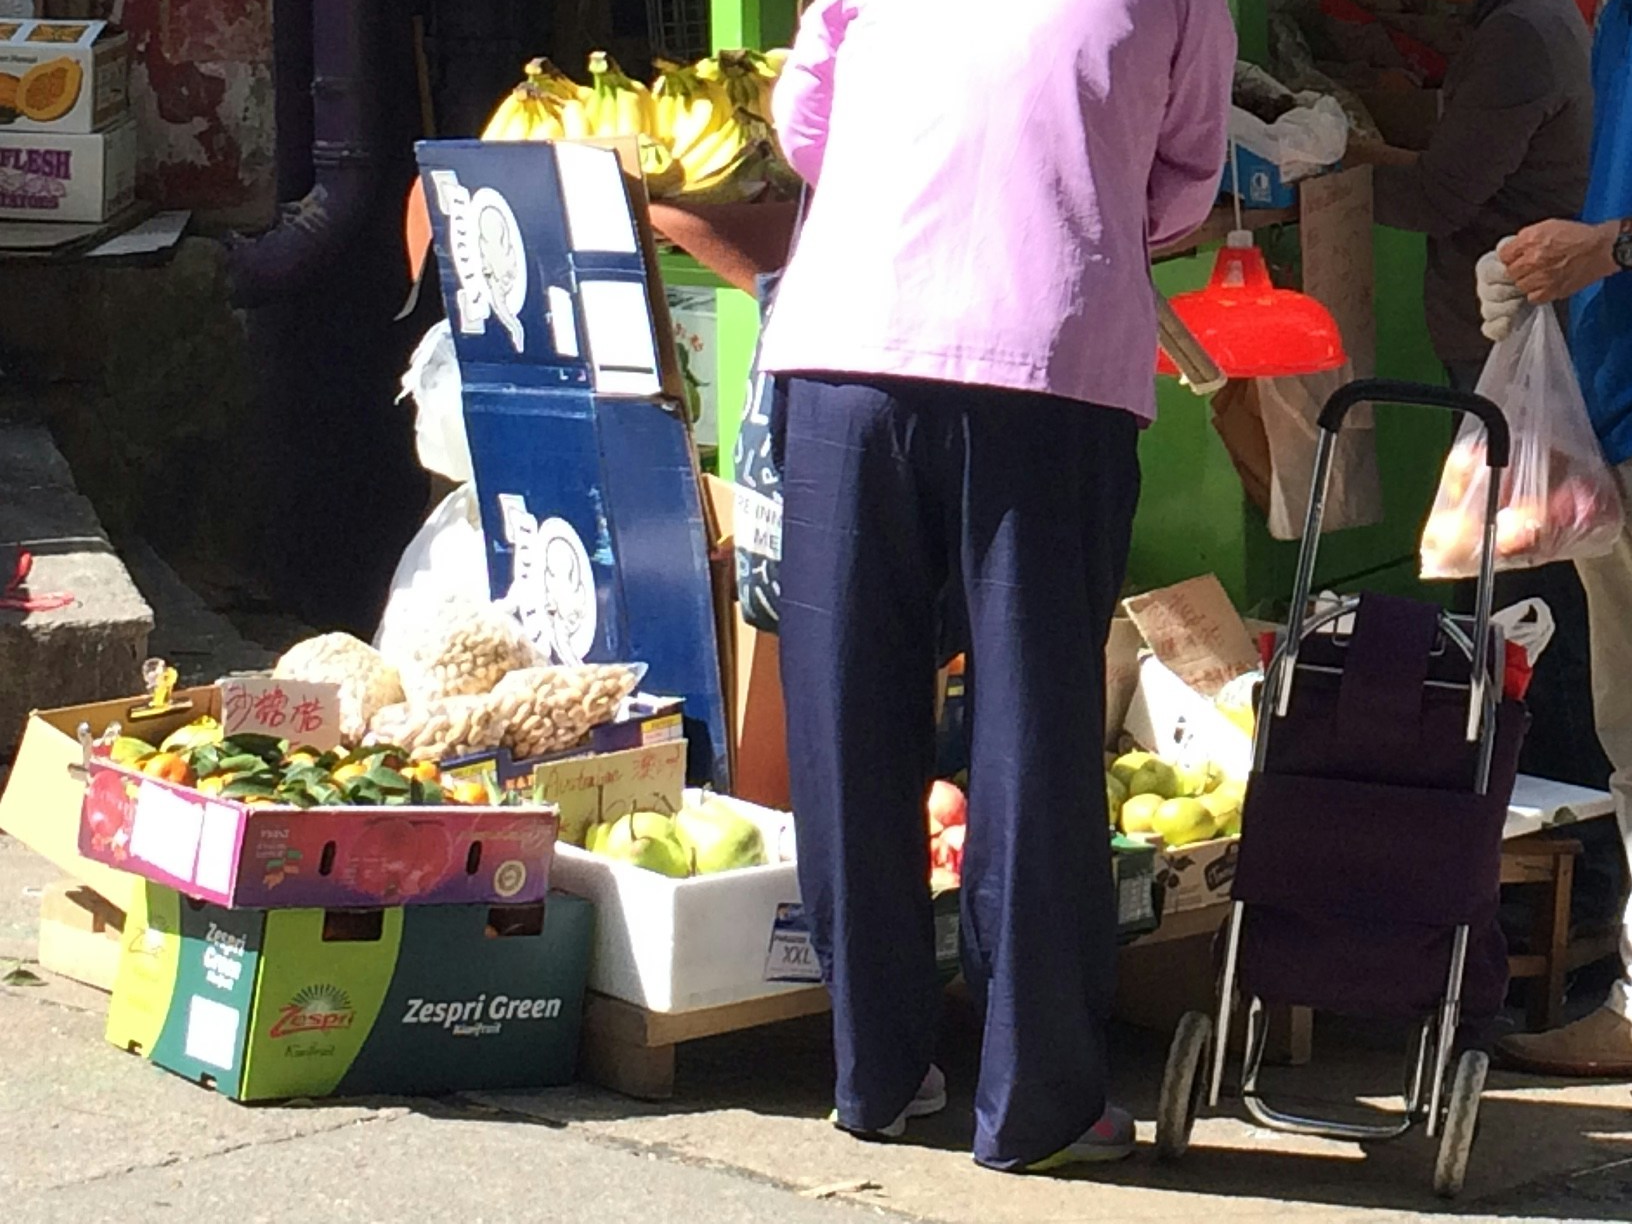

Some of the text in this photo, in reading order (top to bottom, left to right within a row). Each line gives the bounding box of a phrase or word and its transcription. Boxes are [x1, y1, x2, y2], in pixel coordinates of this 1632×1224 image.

[0, 148, 72, 180] FLESH
[782, 945, 811, 965] XXL
[269, 1003, 356, 1039] Zespri
[402, 993, 562, 1029] Zespri Green
